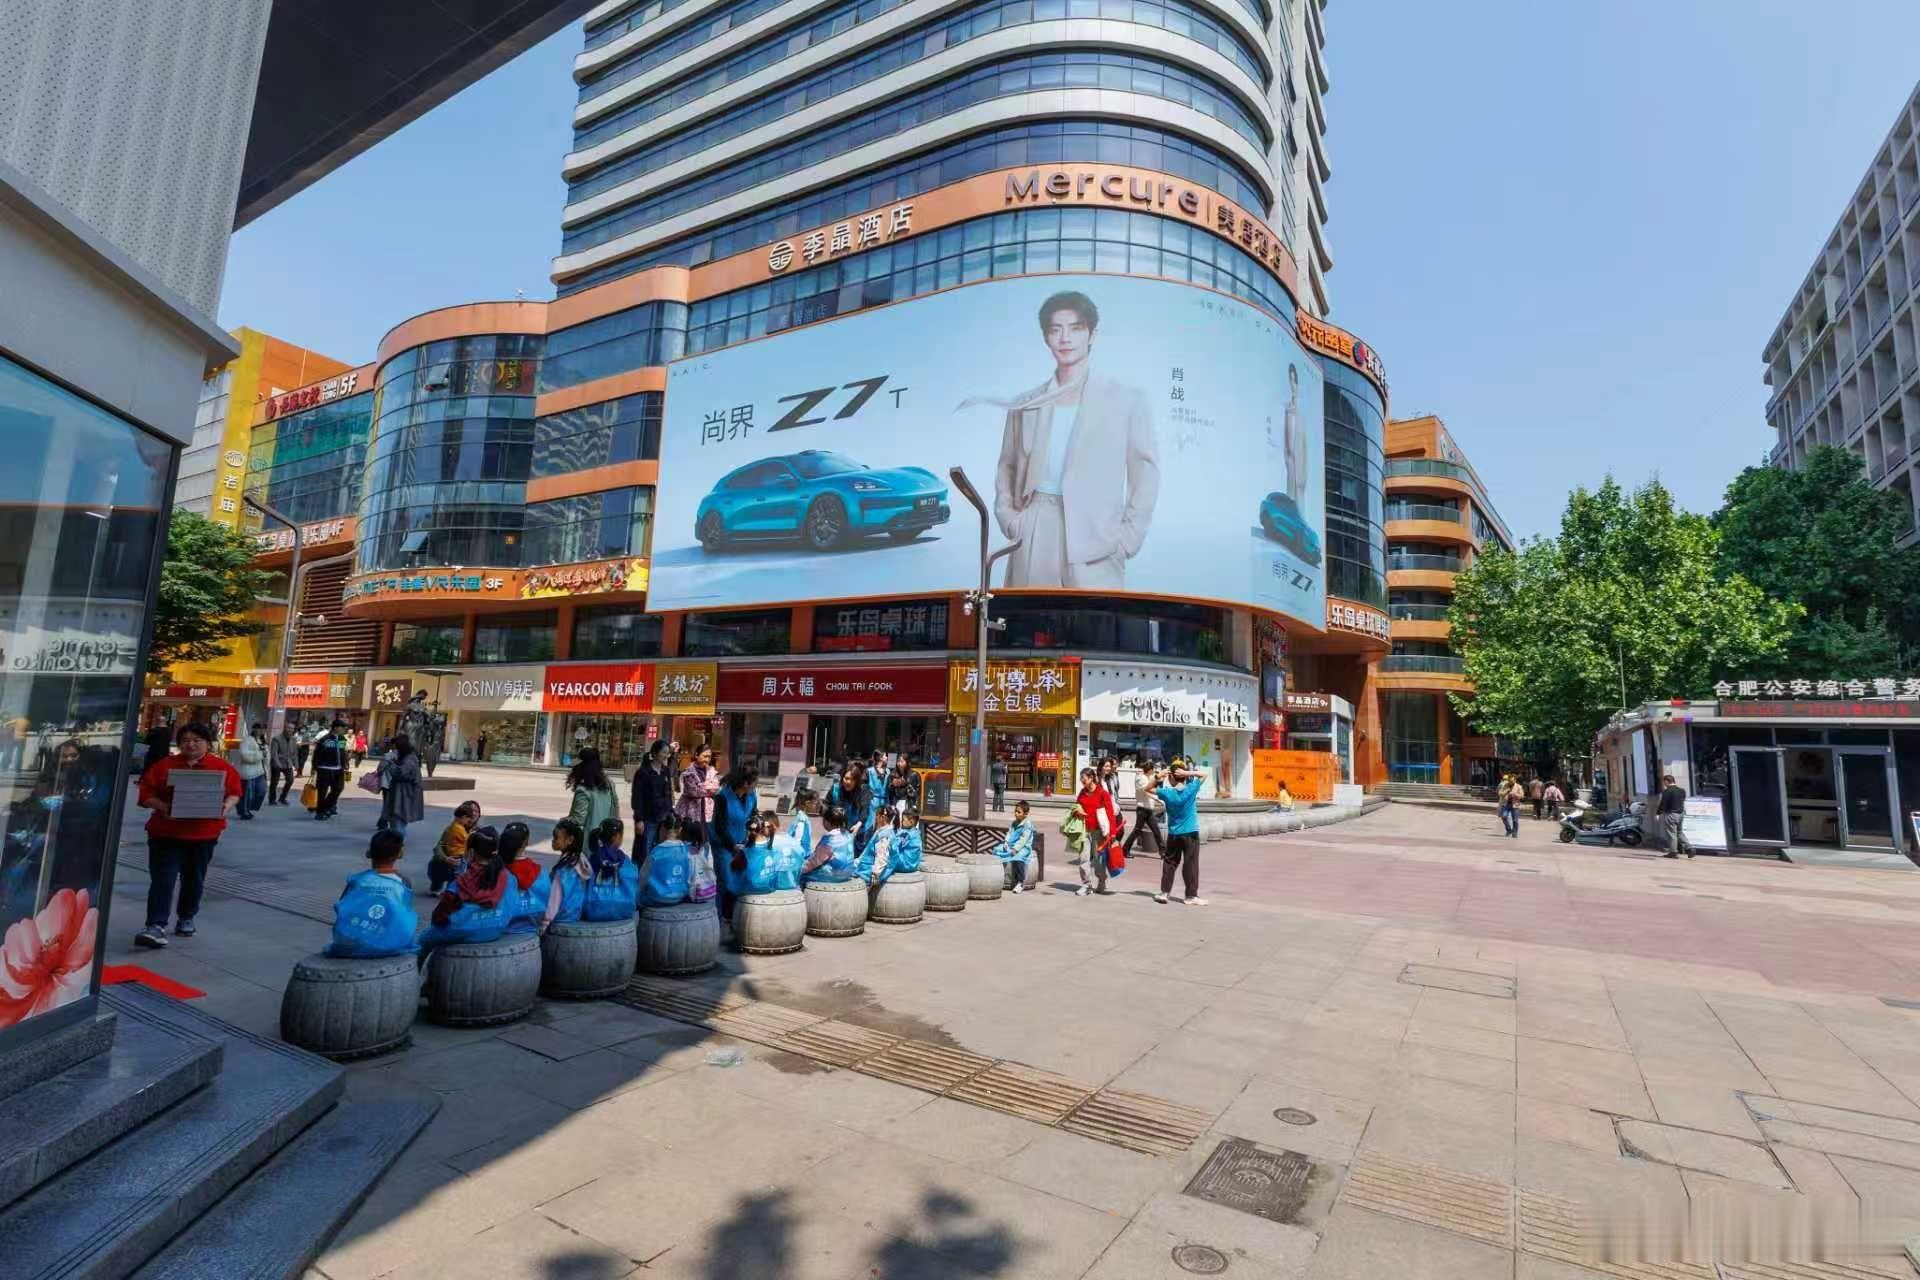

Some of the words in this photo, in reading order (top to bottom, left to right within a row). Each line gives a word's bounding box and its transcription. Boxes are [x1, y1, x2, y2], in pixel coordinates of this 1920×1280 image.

[1005, 169, 1199, 215] Mercure
[803, 203, 913, 261] 季晶酒店
[340, 373, 357, 396] 5F
[1171, 367, 1184, 401] 肖战
[701, 404, 754, 446] 尚界
[486, 578, 504, 590] 3F
[457, 680, 504, 697] JOSINY
[551, 682, 610, 696] YEARCON
[614, 681, 645, 696] 意尔康
[762, 677, 815, 696] 周大福
[826, 682, 849, 691] CHOW
[853, 682, 866, 690] TAI
[869, 681, 893, 690] FOOK
[1713, 678, 1920, 697] 合肥公安综合警务
[984, 692, 1042, 712] 金包银
